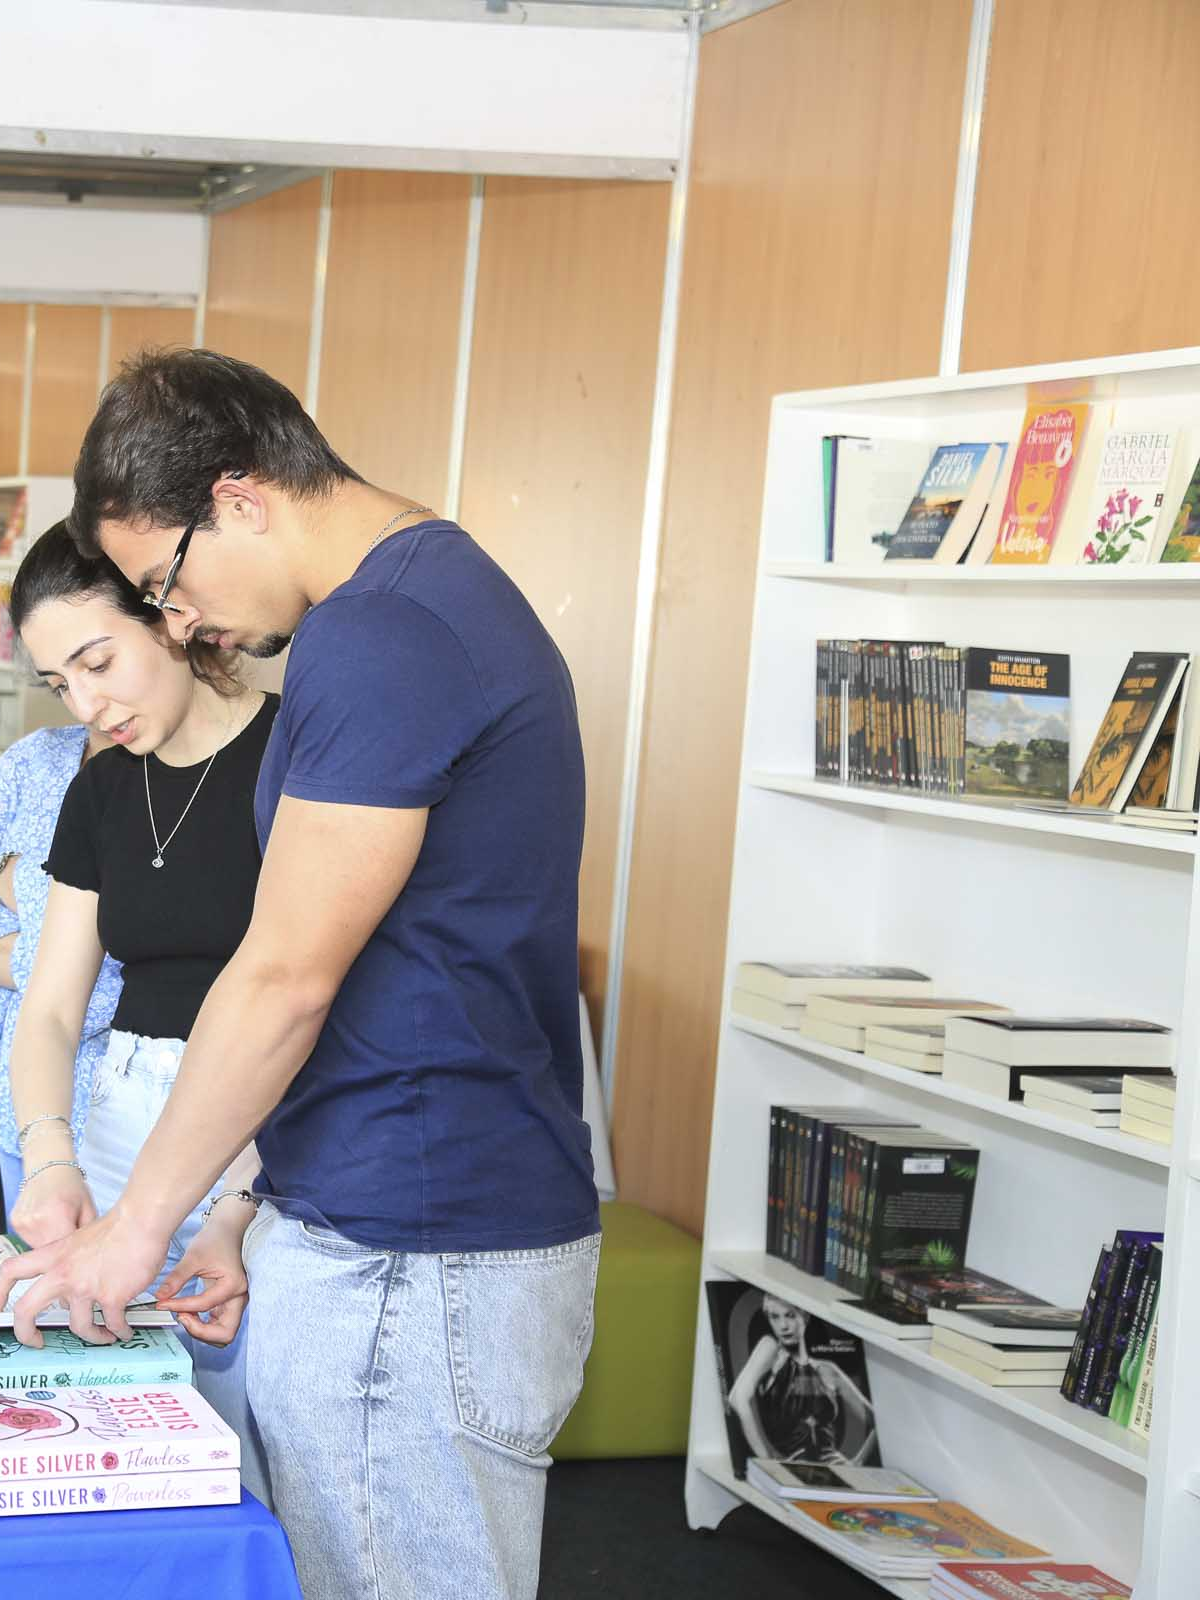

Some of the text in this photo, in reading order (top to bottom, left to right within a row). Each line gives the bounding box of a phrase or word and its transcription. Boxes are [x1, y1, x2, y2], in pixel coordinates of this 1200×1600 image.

[1107, 434, 1170, 449] GABRIEL
[925, 464, 972, 487] SILVA
[990, 661, 1048, 677] THE AGE OF
[990, 674, 1048, 688] INNOCENCE
[109, 1395, 161, 1432] ELSIE
[142, 1390, 200, 1432] SILVER
[36, 1453, 96, 1473] SILVER
[123, 1445, 191, 1470] Flawless
[32, 1487, 89, 1507] SILVER
[111, 1480, 194, 1509] Powerless
